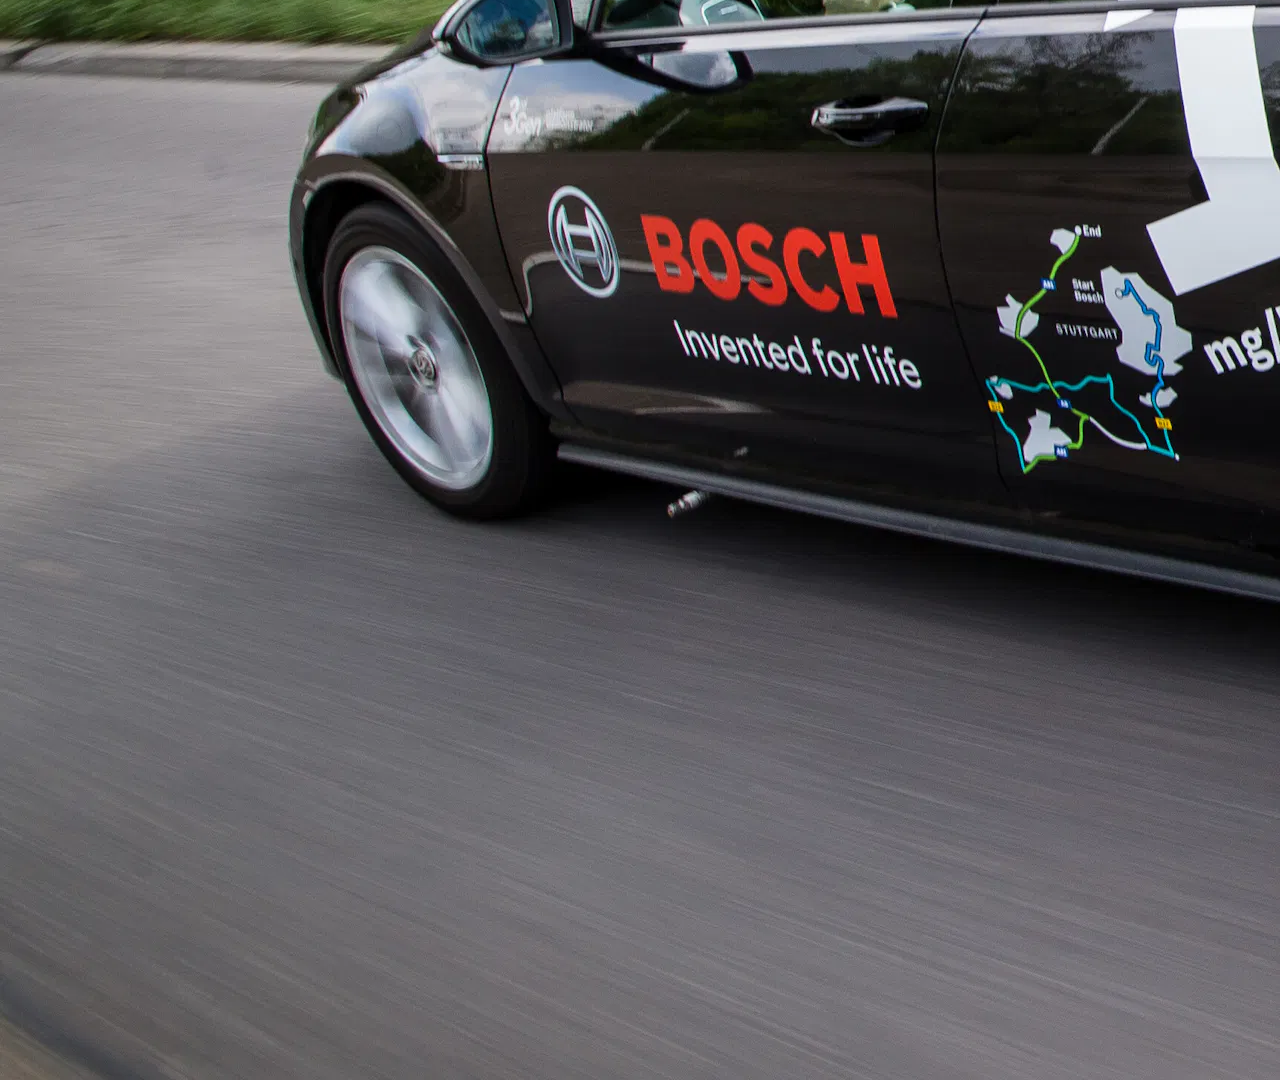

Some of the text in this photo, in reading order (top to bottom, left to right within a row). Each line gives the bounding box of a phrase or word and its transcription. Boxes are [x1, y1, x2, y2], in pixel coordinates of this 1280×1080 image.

[1082, 224, 1102, 238] End
[640, 214, 899, 319] BOSCH
[1072, 278, 1096, 292] Start
[1074, 290, 1104, 304] Bosch
[1055, 323, 1119, 341] STUTTGART
[673, 319, 923, 390] Invented for life
